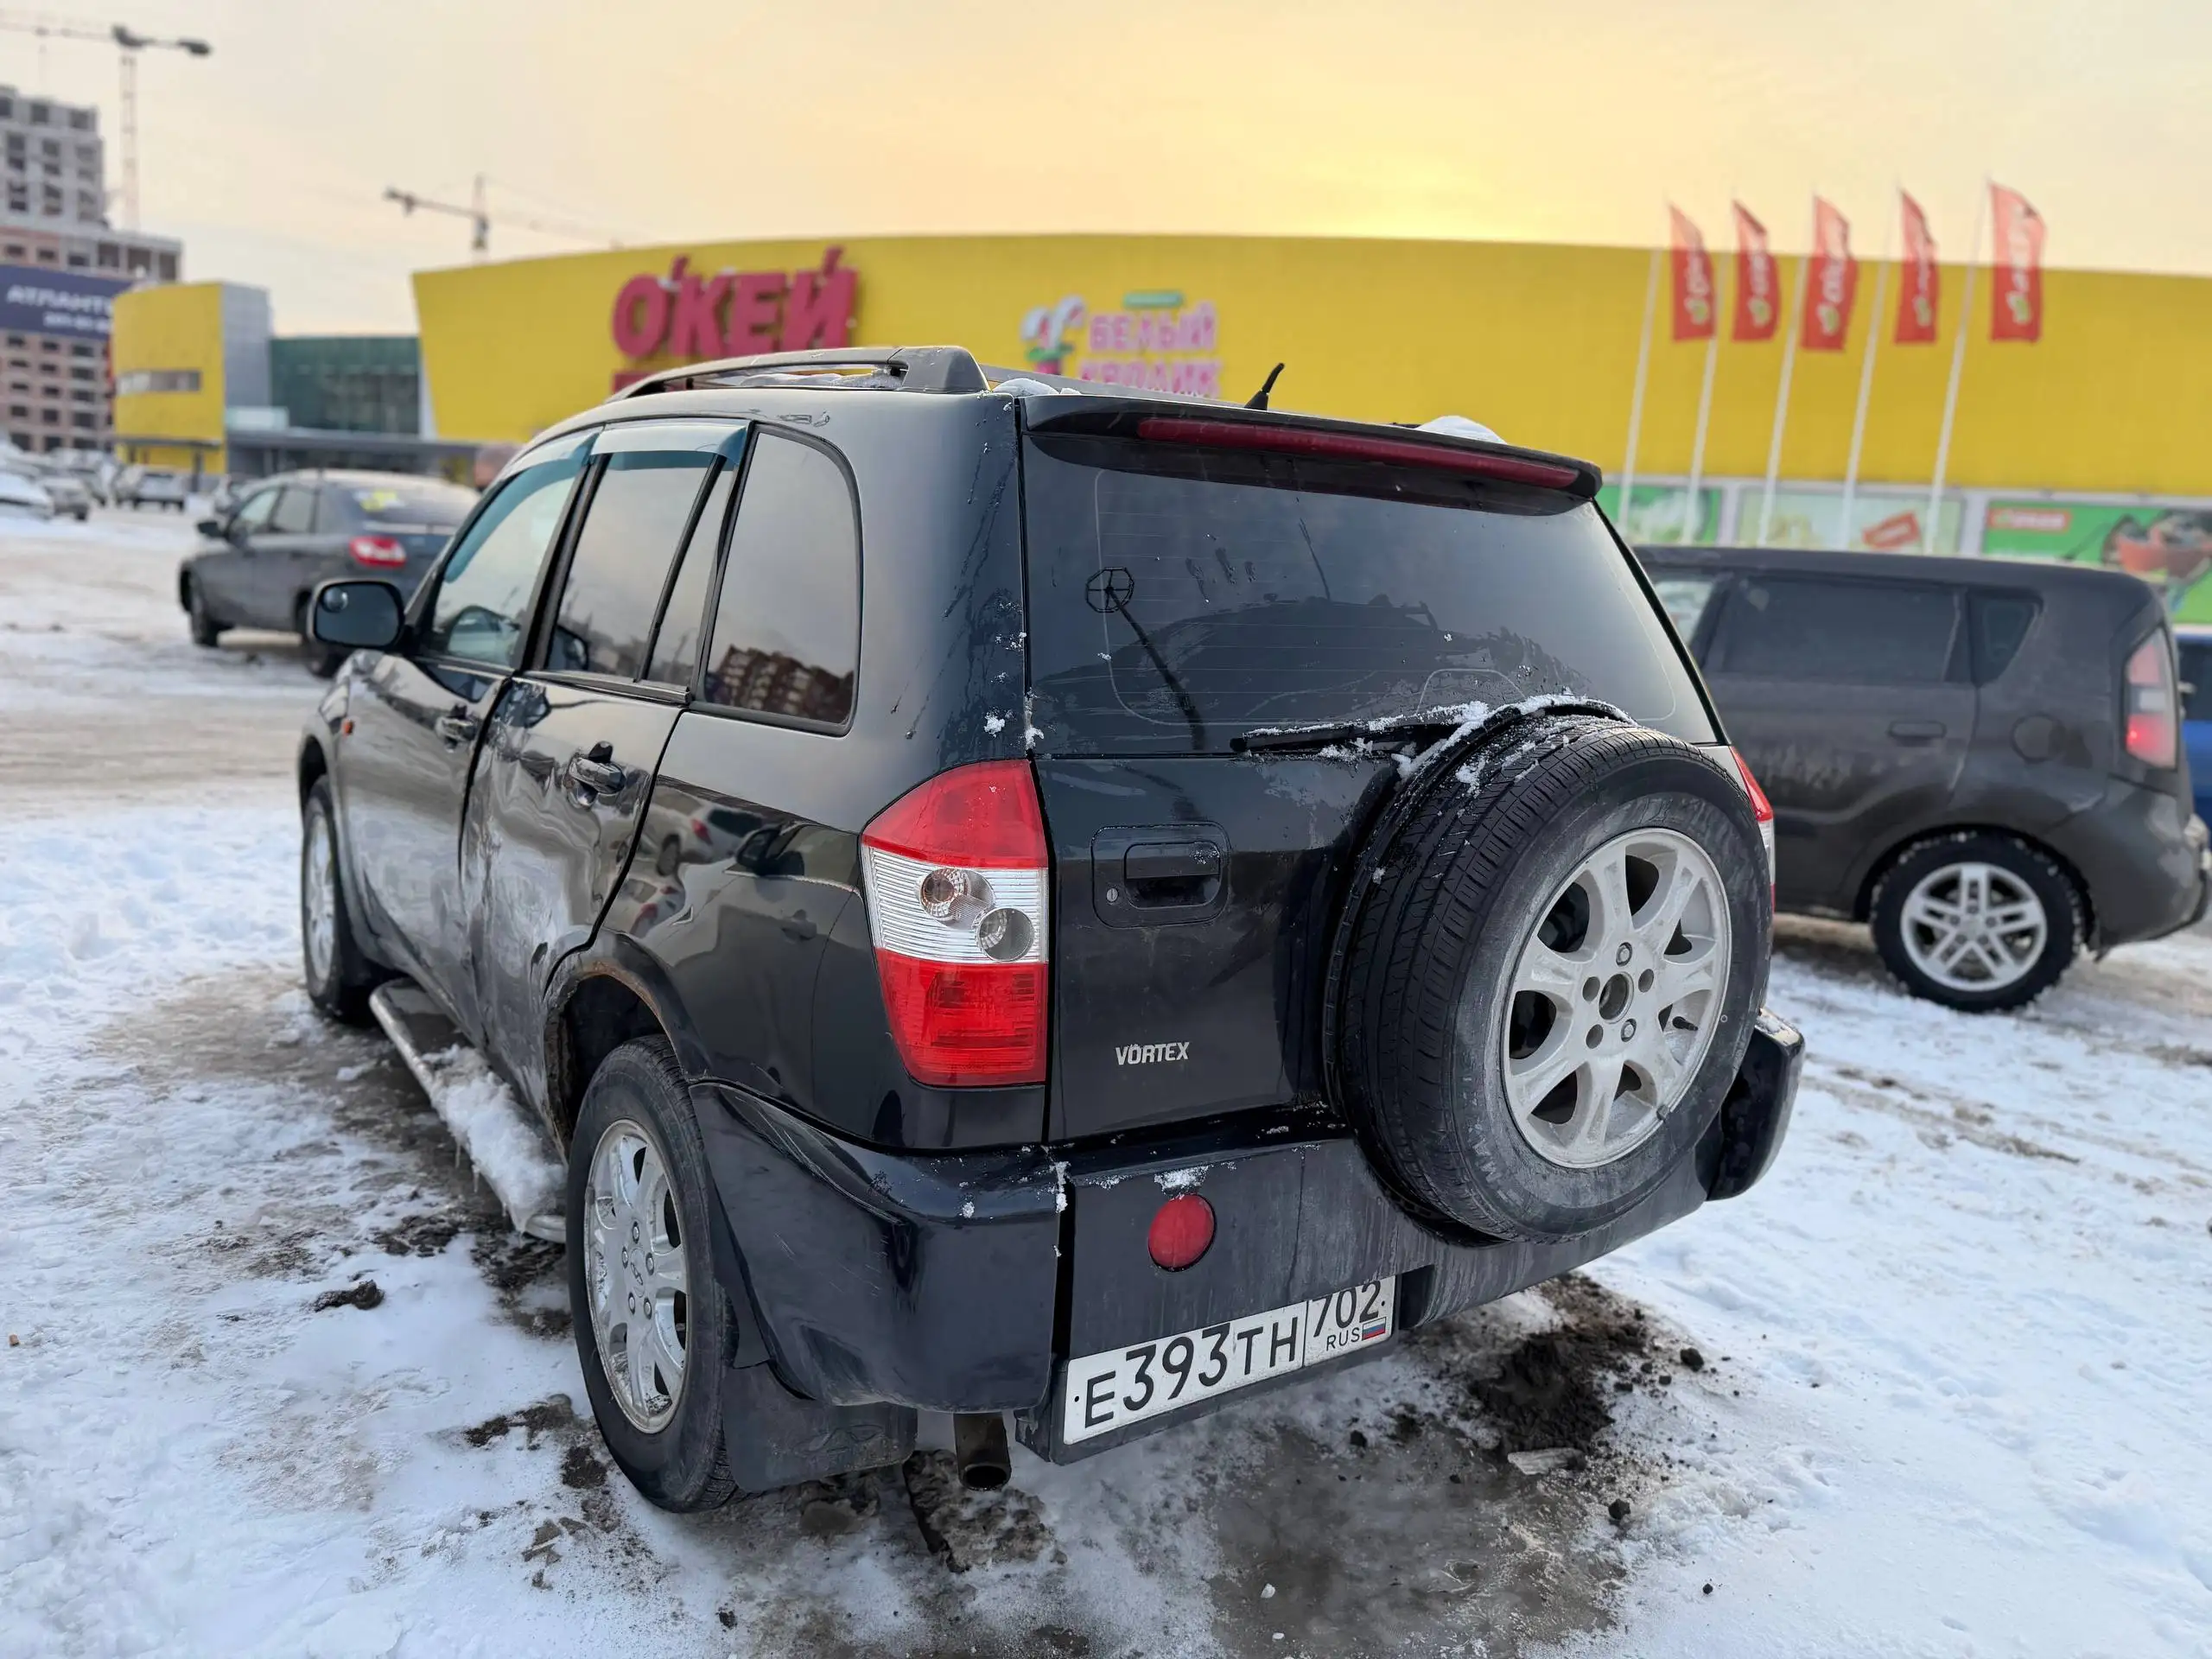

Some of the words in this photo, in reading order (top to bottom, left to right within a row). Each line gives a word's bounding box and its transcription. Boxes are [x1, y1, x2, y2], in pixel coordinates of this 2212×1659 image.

[613, 245, 860, 359] О'КЕЙ
[1089, 301, 1217, 352] БЕЛЫЙ
[1325, 1331, 1360, 1351] RUS
